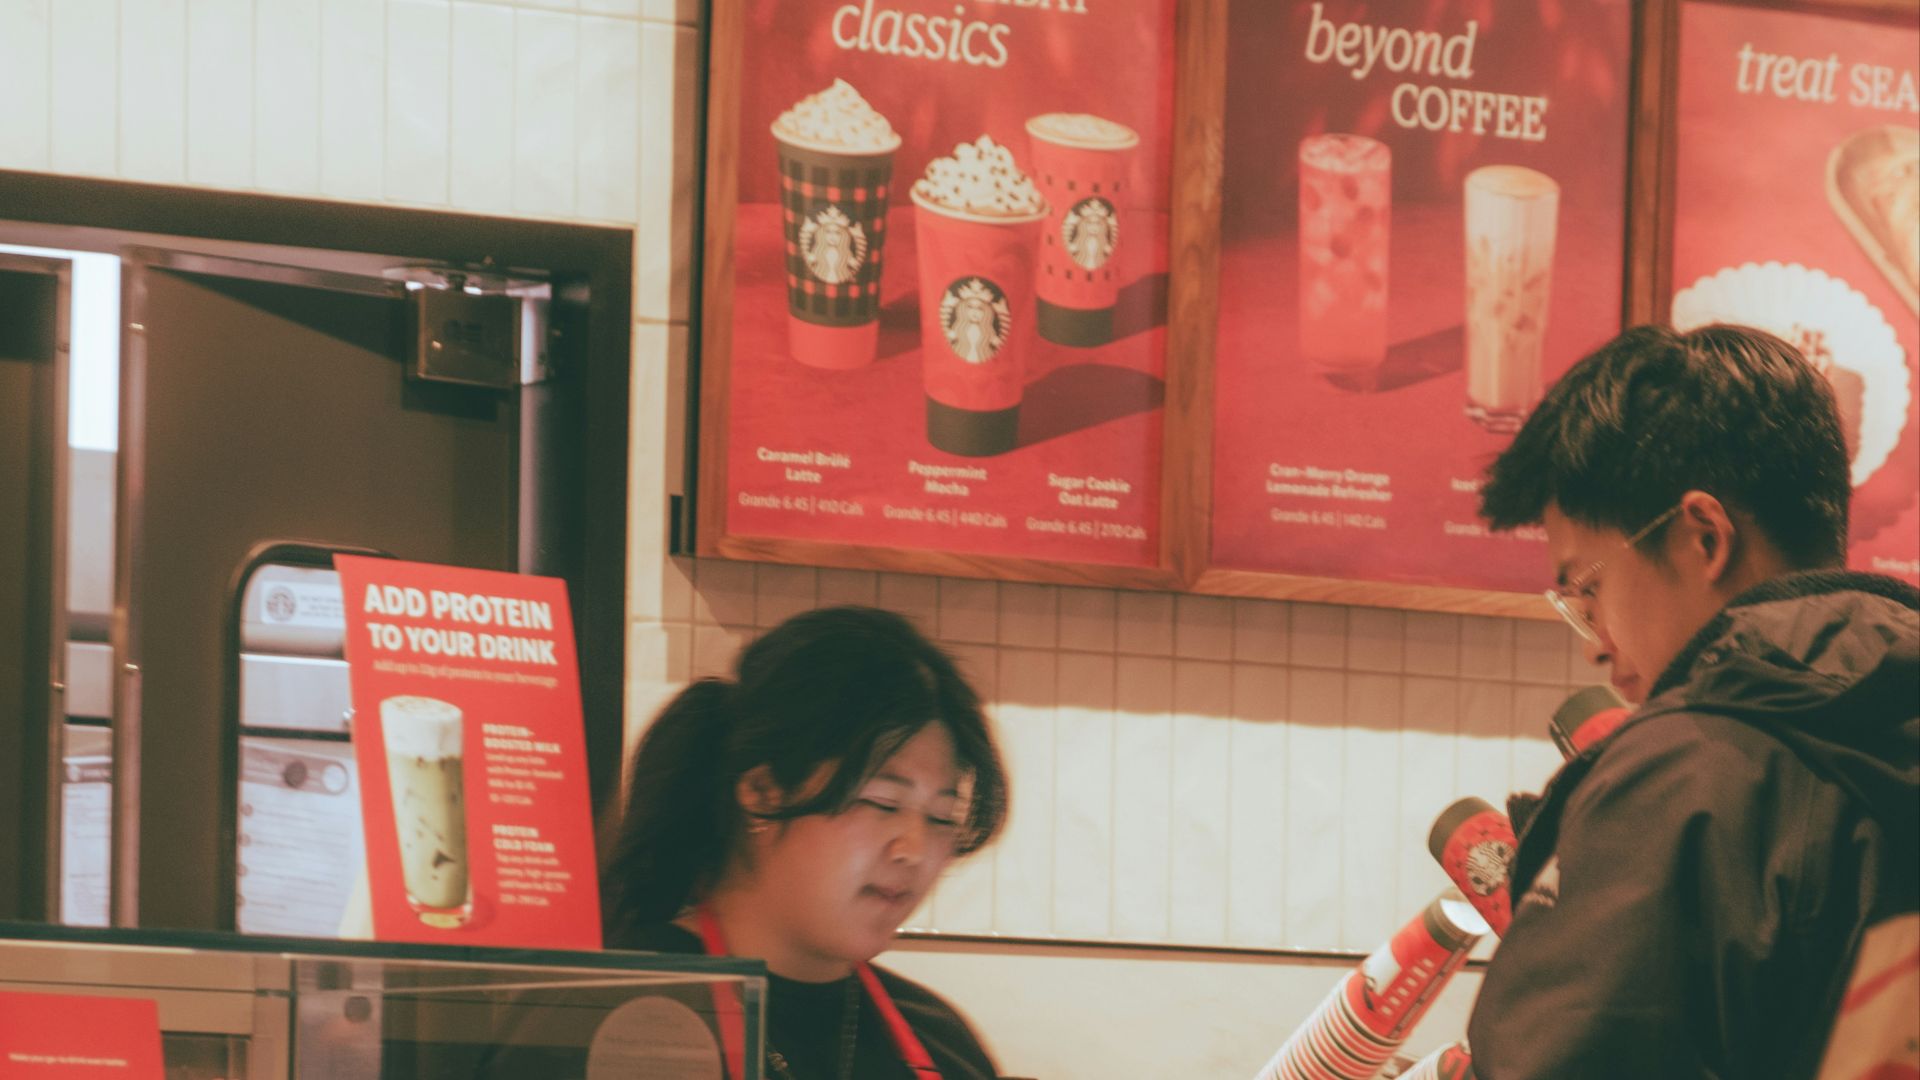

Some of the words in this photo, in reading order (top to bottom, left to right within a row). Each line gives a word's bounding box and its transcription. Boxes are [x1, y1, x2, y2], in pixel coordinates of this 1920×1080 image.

[831, 0, 1011, 67] classics
[1305, 2, 1478, 80] beyond
[1736, 41, 1842, 103] treat
[1391, 83, 1548, 142] COFFEE
[757, 447, 813, 464] Caramel
[786, 467, 822, 483] Latte
[908, 460, 987, 479] Peppermint
[1269, 462, 1342, 482] Cran-Merry
[1343, 468, 1390, 487] Orange
[924, 479, 969, 495] Mocha
[1048, 473, 1085, 489] Sugar
[1086, 476, 1131, 492] Cookie
[1266, 479, 1329, 496] Lemonade
[1331, 484, 1393, 501] Refresher
[739, 491, 781, 507] Grande
[1058, 491, 1083, 505] Oat
[1084, 493, 1118, 508] Latte
[883, 504, 924, 520] Grande
[1270, 507, 1309, 522] Grande
[1026, 516, 1065, 532] Grande
[1444, 520, 1482, 536] Grande
[364, 583, 426, 618] ADD
[429, 590, 554, 631] PROTEIN
[366, 622, 403, 651] TO
[404, 625, 476, 658] YOUR
[479, 633, 558, 666] DRINK
